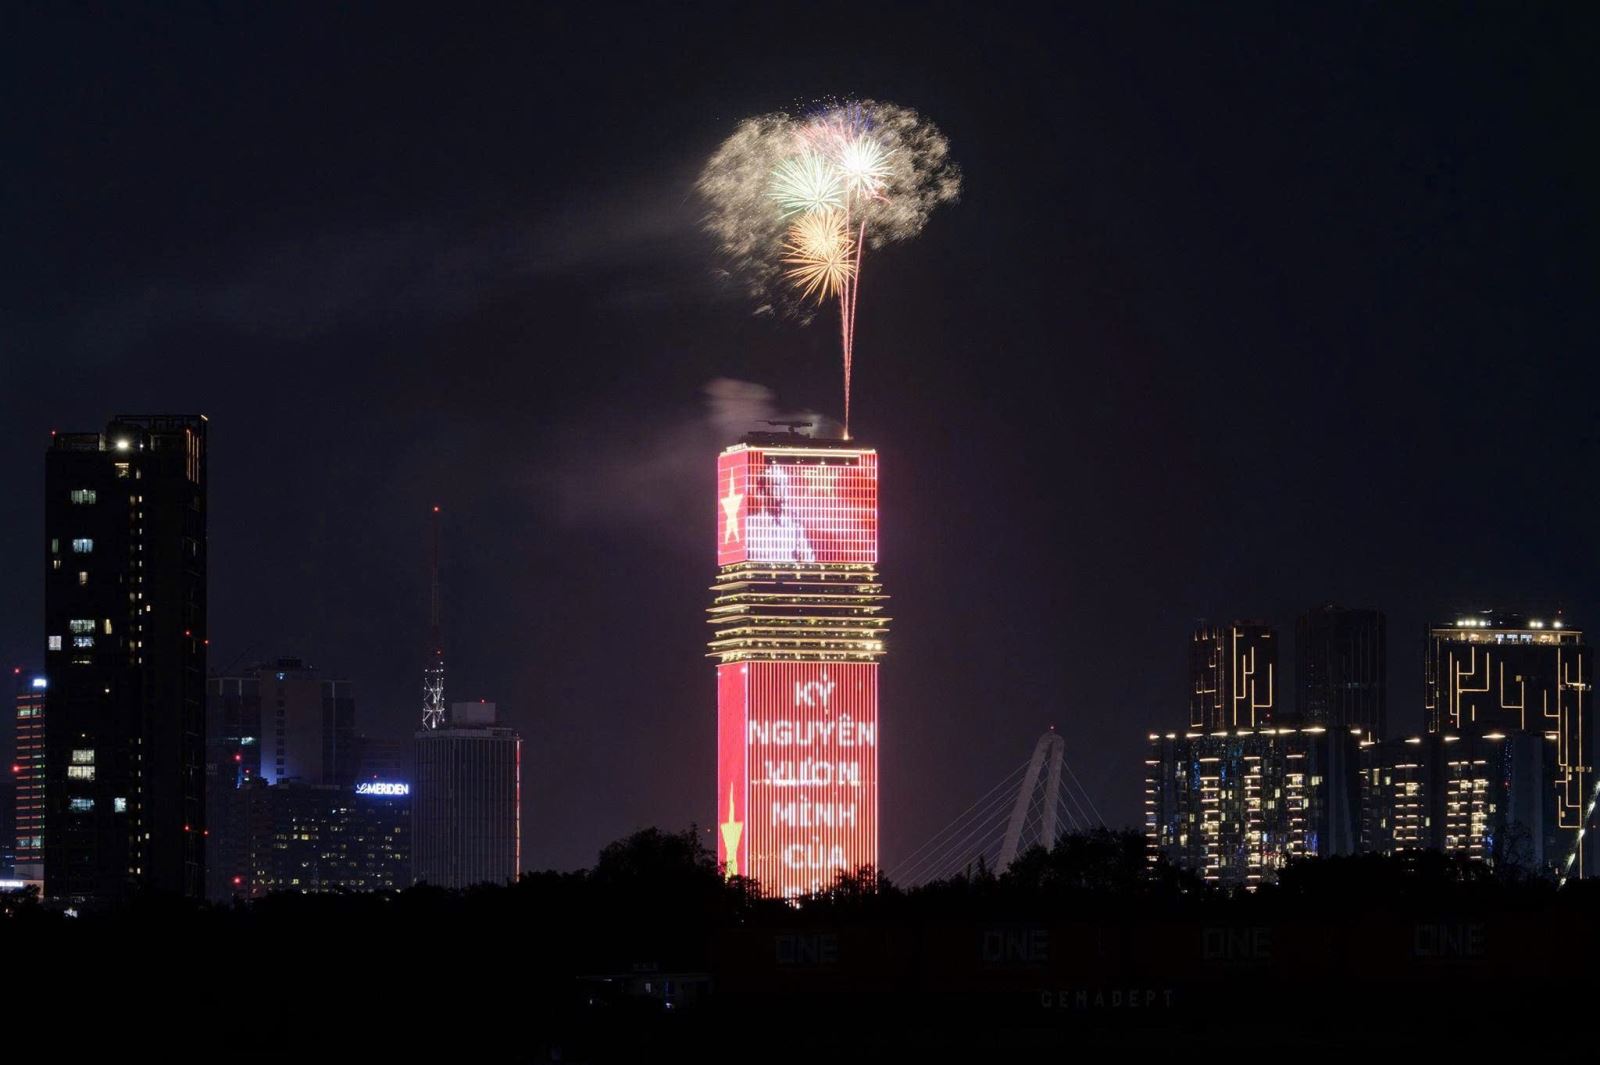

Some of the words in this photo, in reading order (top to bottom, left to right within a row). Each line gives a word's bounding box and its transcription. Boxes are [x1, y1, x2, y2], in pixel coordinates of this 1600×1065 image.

[749, 713, 875, 746] NGUYÊN
[983, 929, 1049, 961] ONE
[1202, 928, 1271, 960] ONE
[1041, 990, 1175, 1008] GEMADEPT
